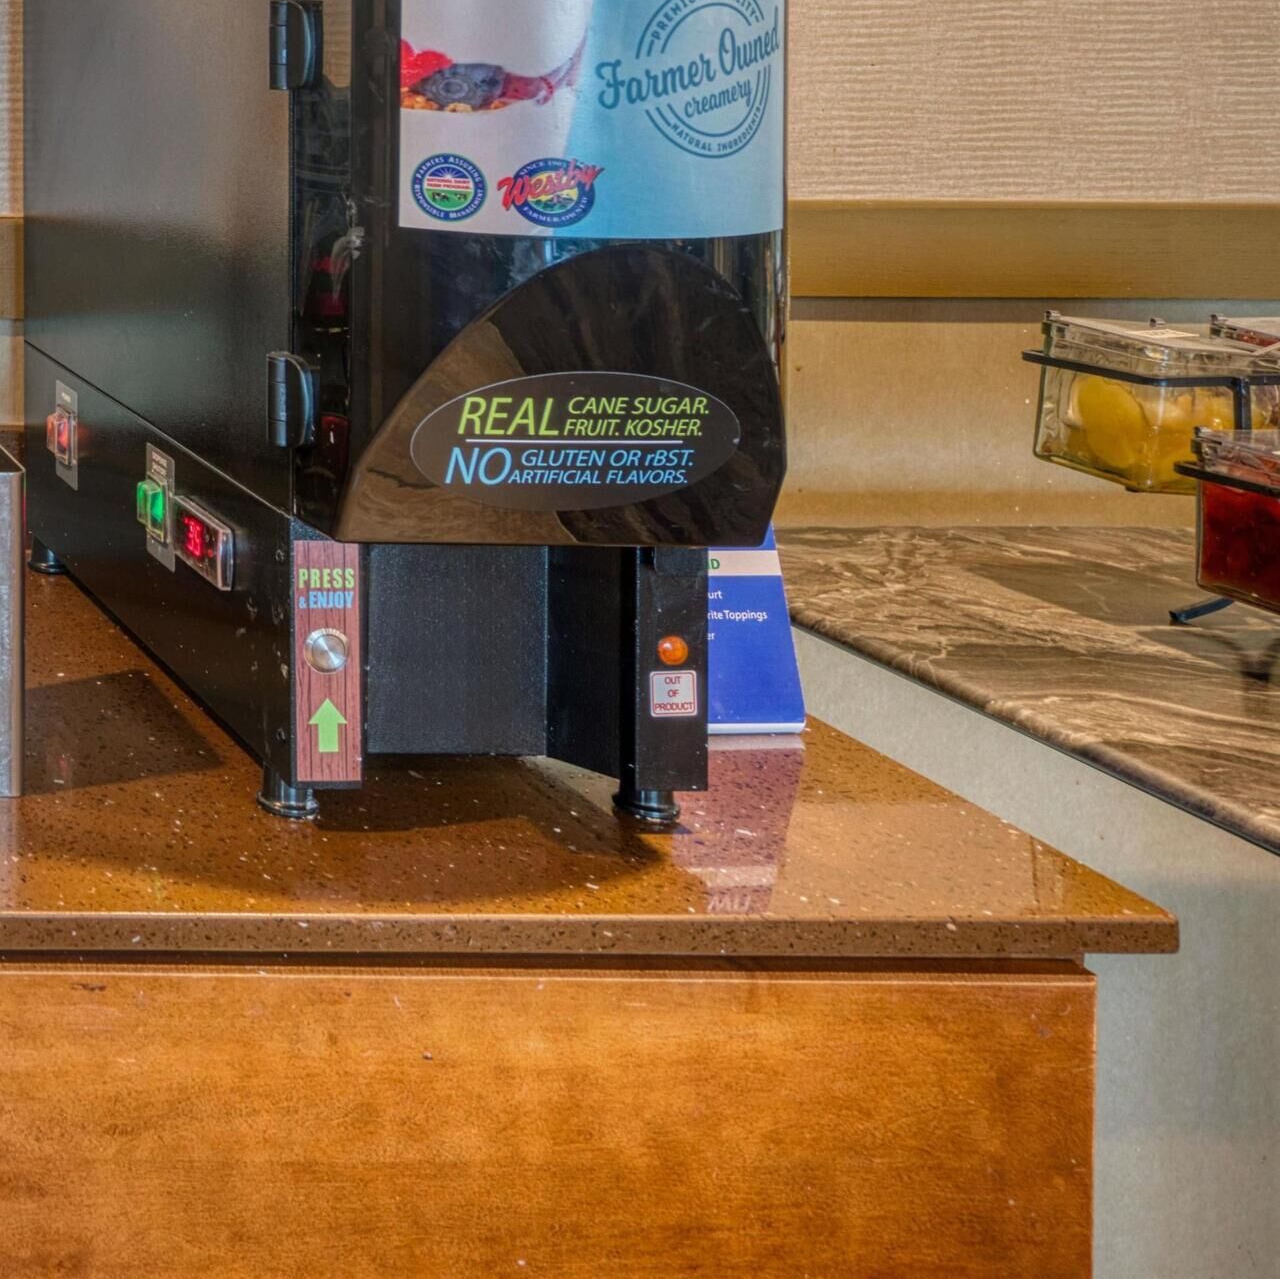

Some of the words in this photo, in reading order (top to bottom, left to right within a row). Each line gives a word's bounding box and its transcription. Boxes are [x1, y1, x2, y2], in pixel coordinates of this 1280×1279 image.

[594, 52, 717, 110] Farmer
[718, 4, 780, 76] Owned
[684, 79, 752, 119] creamery
[670, 123, 712, 152] NATURAL
[717, 105, 761, 152] INGREDIENTS
[497, 158, 605, 211] Westby
[568, 397, 627, 414] CANE
[631, 397, 709, 415] SUGAR.
[457, 397, 560, 436] REAL
[563, 419, 619, 436] FRUIT.
[625, 419, 703, 437] KOSHER.
[444, 447, 512, 485] NO
[521, 449, 605, 467] GLUTEN
[610, 449, 641, 466] OR
[644, 449, 694, 467] rBST.
[508, 470, 602, 484] ARTIFICIAL
[606, 470, 688, 484] FLAVORS.
[298, 568, 355, 589] PRESS
[298, 596, 307, 609] &
[309, 591, 354, 609] ENJOY
[723, 609, 768, 622] Toppings
[664, 676, 682, 685] OUT
[667, 689, 679, 698] OF
[654, 702, 694, 711] PRODUCT
